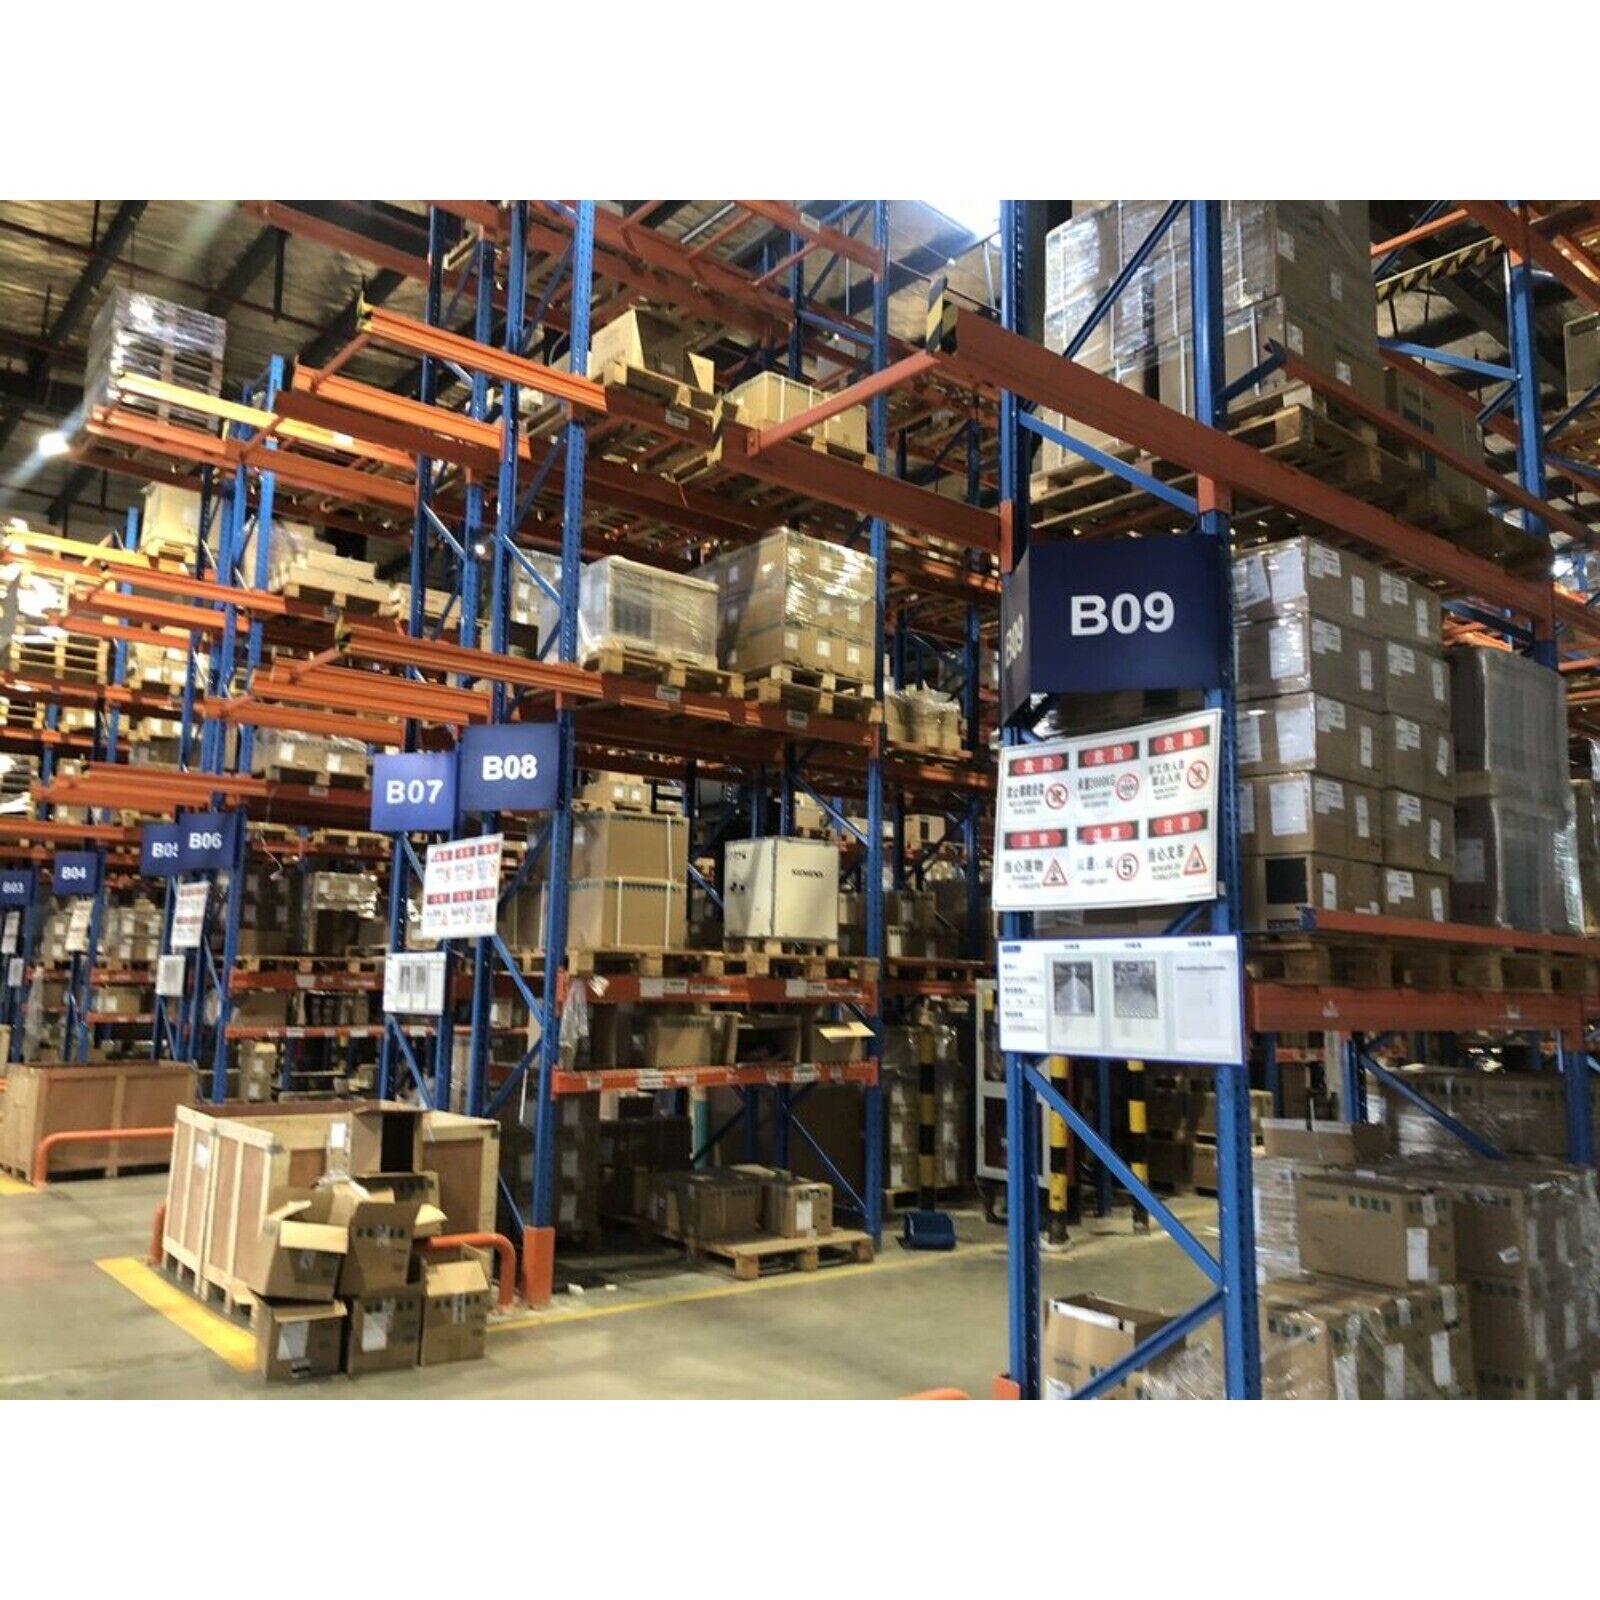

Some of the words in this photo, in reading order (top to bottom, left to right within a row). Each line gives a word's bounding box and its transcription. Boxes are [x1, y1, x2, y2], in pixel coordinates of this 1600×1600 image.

[1071, 591, 1175, 636] B09
[482, 754, 538, 781] B08
[386, 779, 444, 804] B07
[189, 832, 223, 850] B06
[61, 866, 87, 880] B04
[1122, 858, 1133, 876] 5
[2, 881, 25, 893] B03
